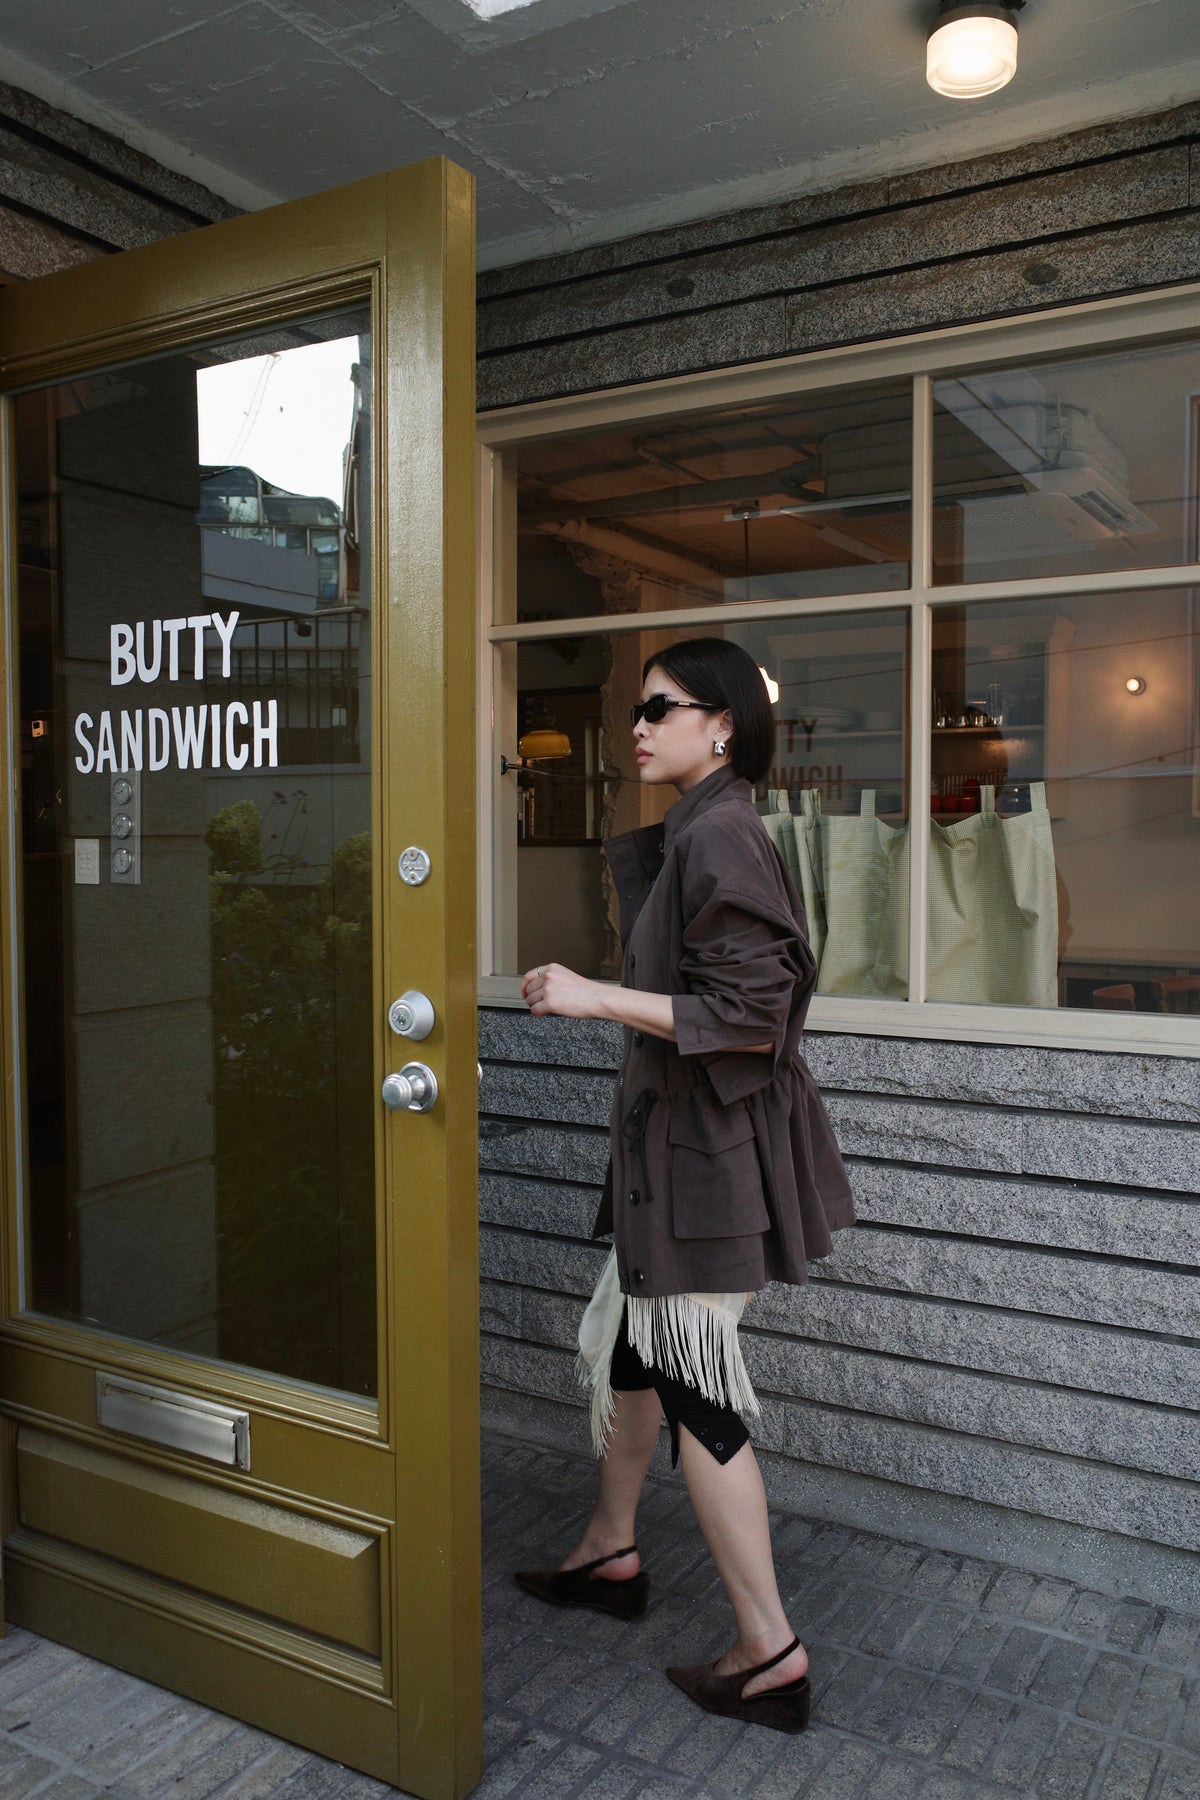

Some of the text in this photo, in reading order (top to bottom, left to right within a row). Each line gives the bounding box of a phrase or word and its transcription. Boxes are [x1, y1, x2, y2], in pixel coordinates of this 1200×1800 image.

[110, 611, 240, 686] BUTTY
[74, 699, 279, 774] SANDWICH
[402, 861, 424, 872] PULL
